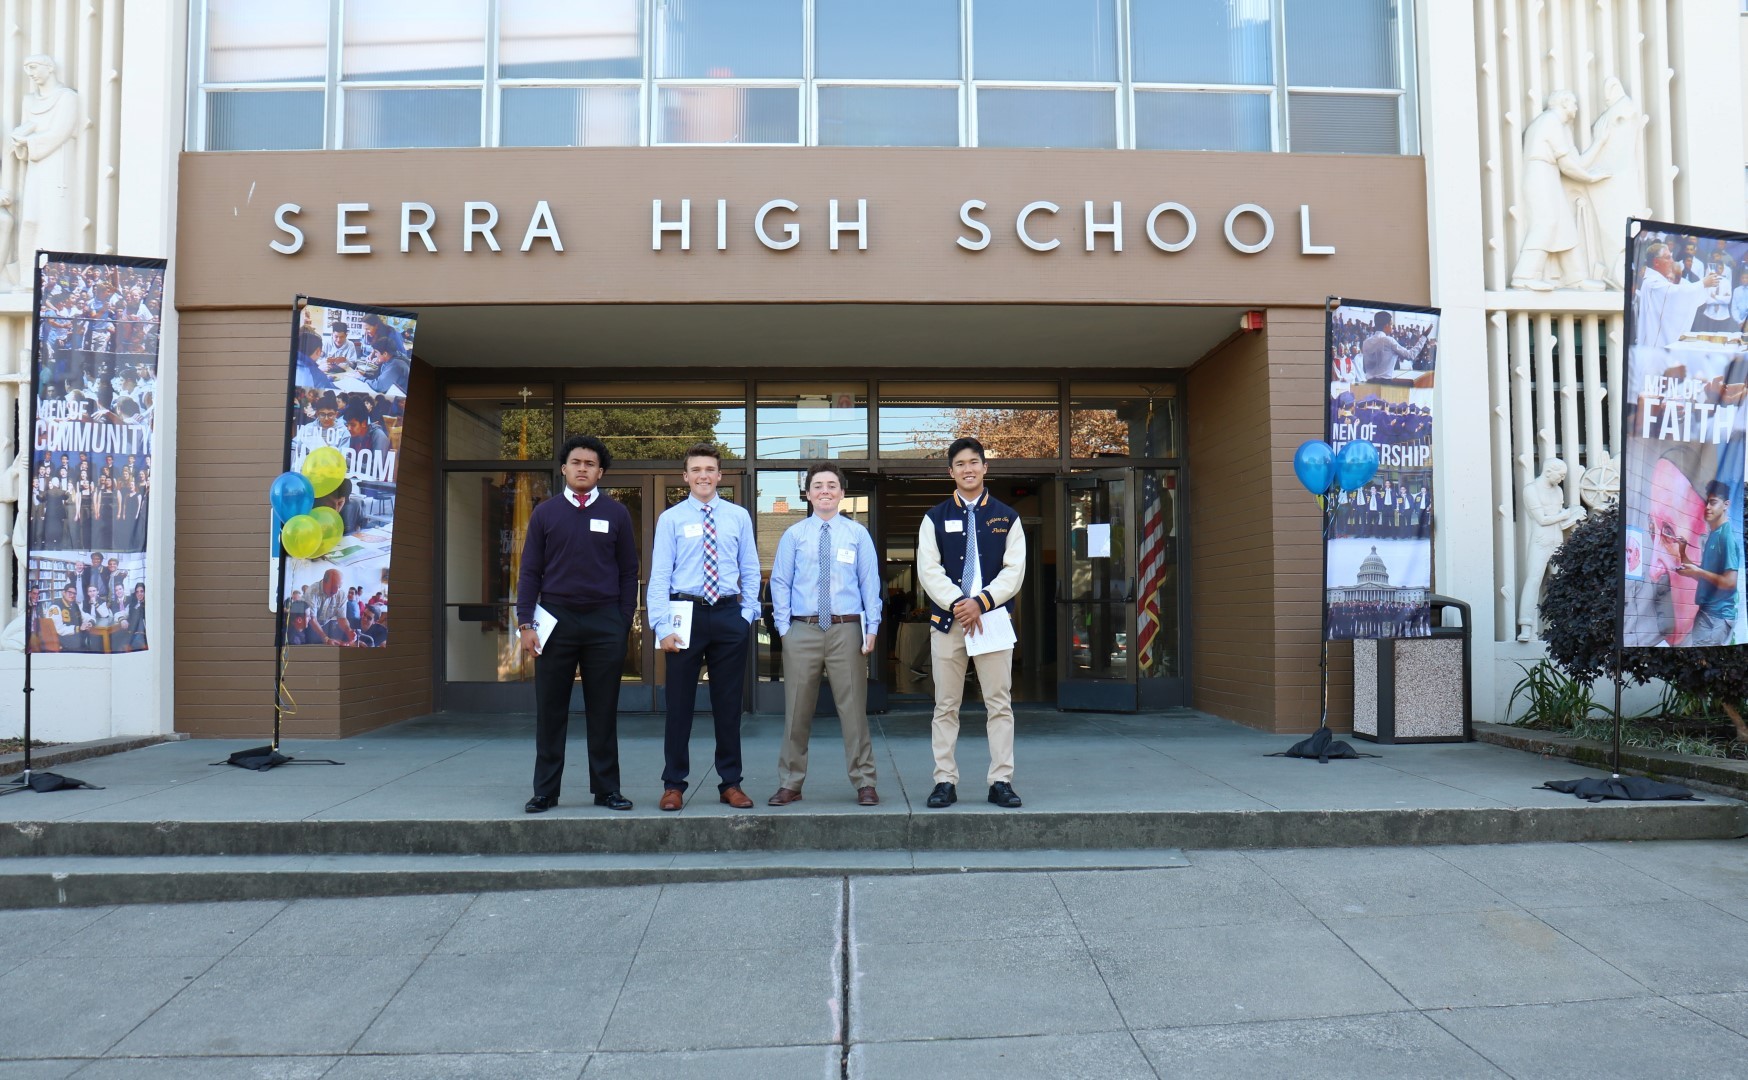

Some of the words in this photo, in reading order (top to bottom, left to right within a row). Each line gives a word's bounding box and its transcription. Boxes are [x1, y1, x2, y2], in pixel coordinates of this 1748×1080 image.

[268, 200, 564, 254] SERRA
[652, 199, 868, 250] HIGH
[955, 199, 1336, 255] SCHOOL
[1644, 375, 1679, 399] MEN
[1683, 379, 1703, 401] OF
[36, 397, 67, 419] MEN
[68, 400, 89, 420] OF
[1642, 398, 1736, 445] FAITH
[34, 420, 150, 454] COMMUNITY
[1361, 423, 1378, 441] OF
